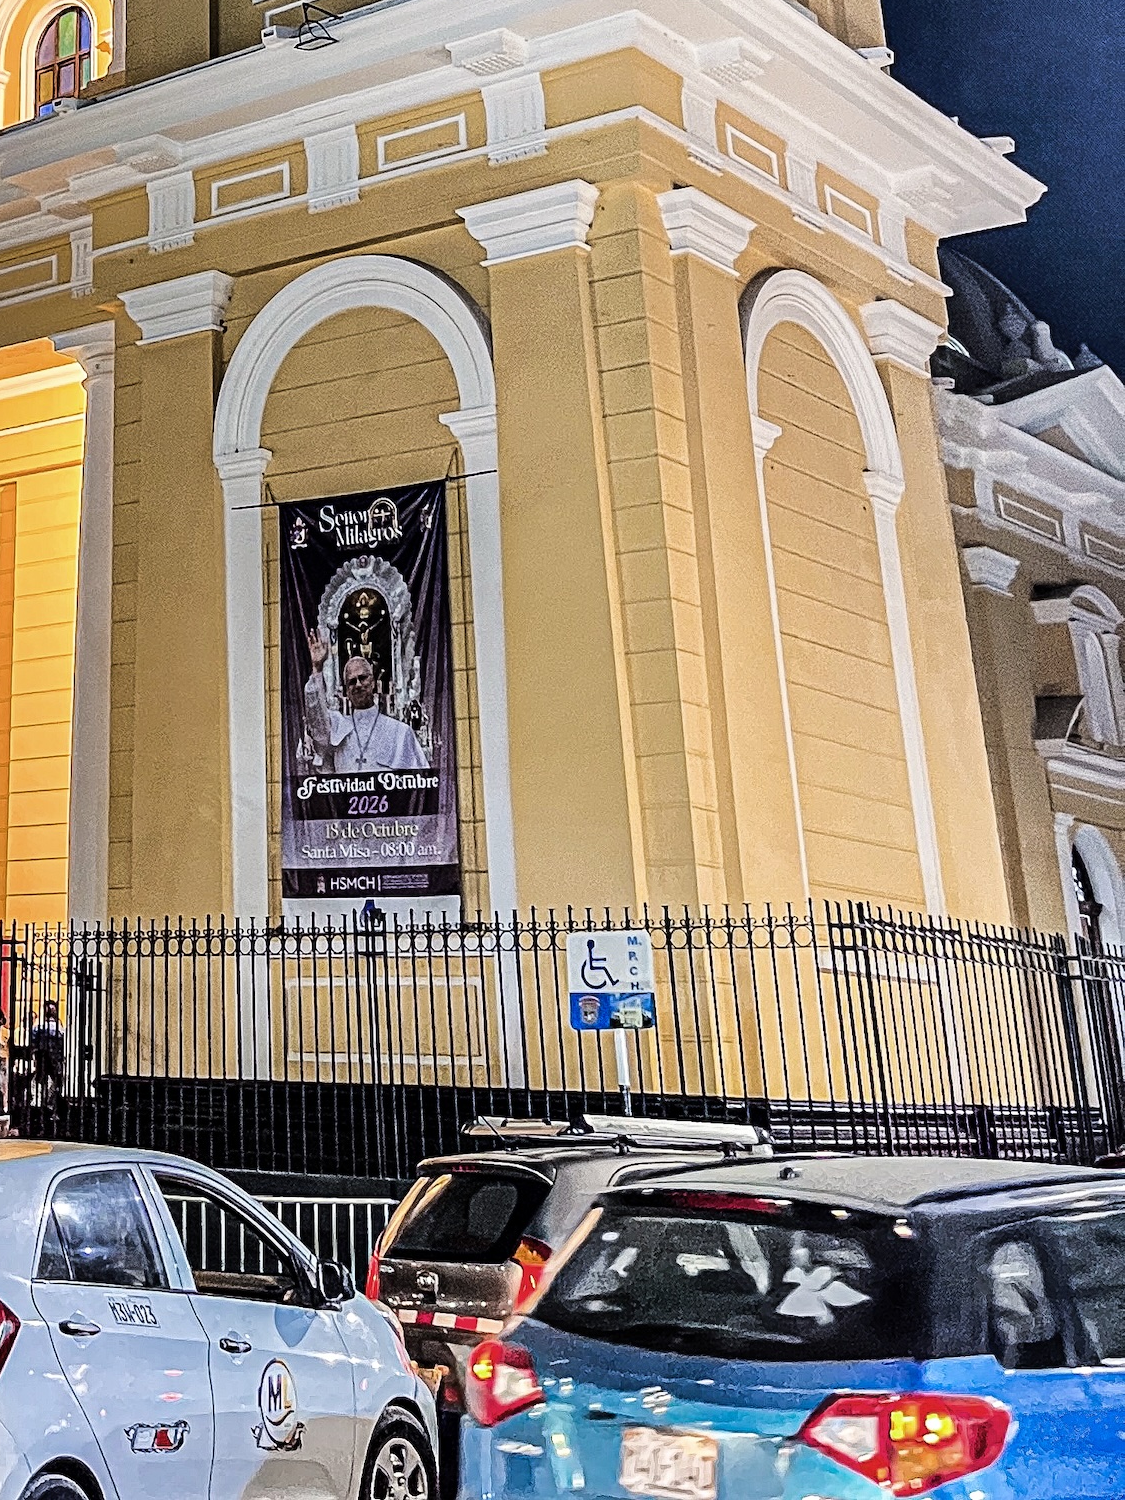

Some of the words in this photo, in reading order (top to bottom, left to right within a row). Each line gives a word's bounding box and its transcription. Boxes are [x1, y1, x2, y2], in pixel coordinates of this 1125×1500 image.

[297, 776, 375, 799] Festividad
[378, 773, 439, 790] Octubre
[348, 795, 389, 814] 2026
[342, 822, 359, 838] de
[362, 820, 419, 838] Octubre
[302, 845, 336, 859] Santa
[339, 843, 370, 858] Misa
[380, 841, 415, 857] 08:00
[330, 876, 375, 891] HSMCH
[268, 1374, 292, 1412] ML
